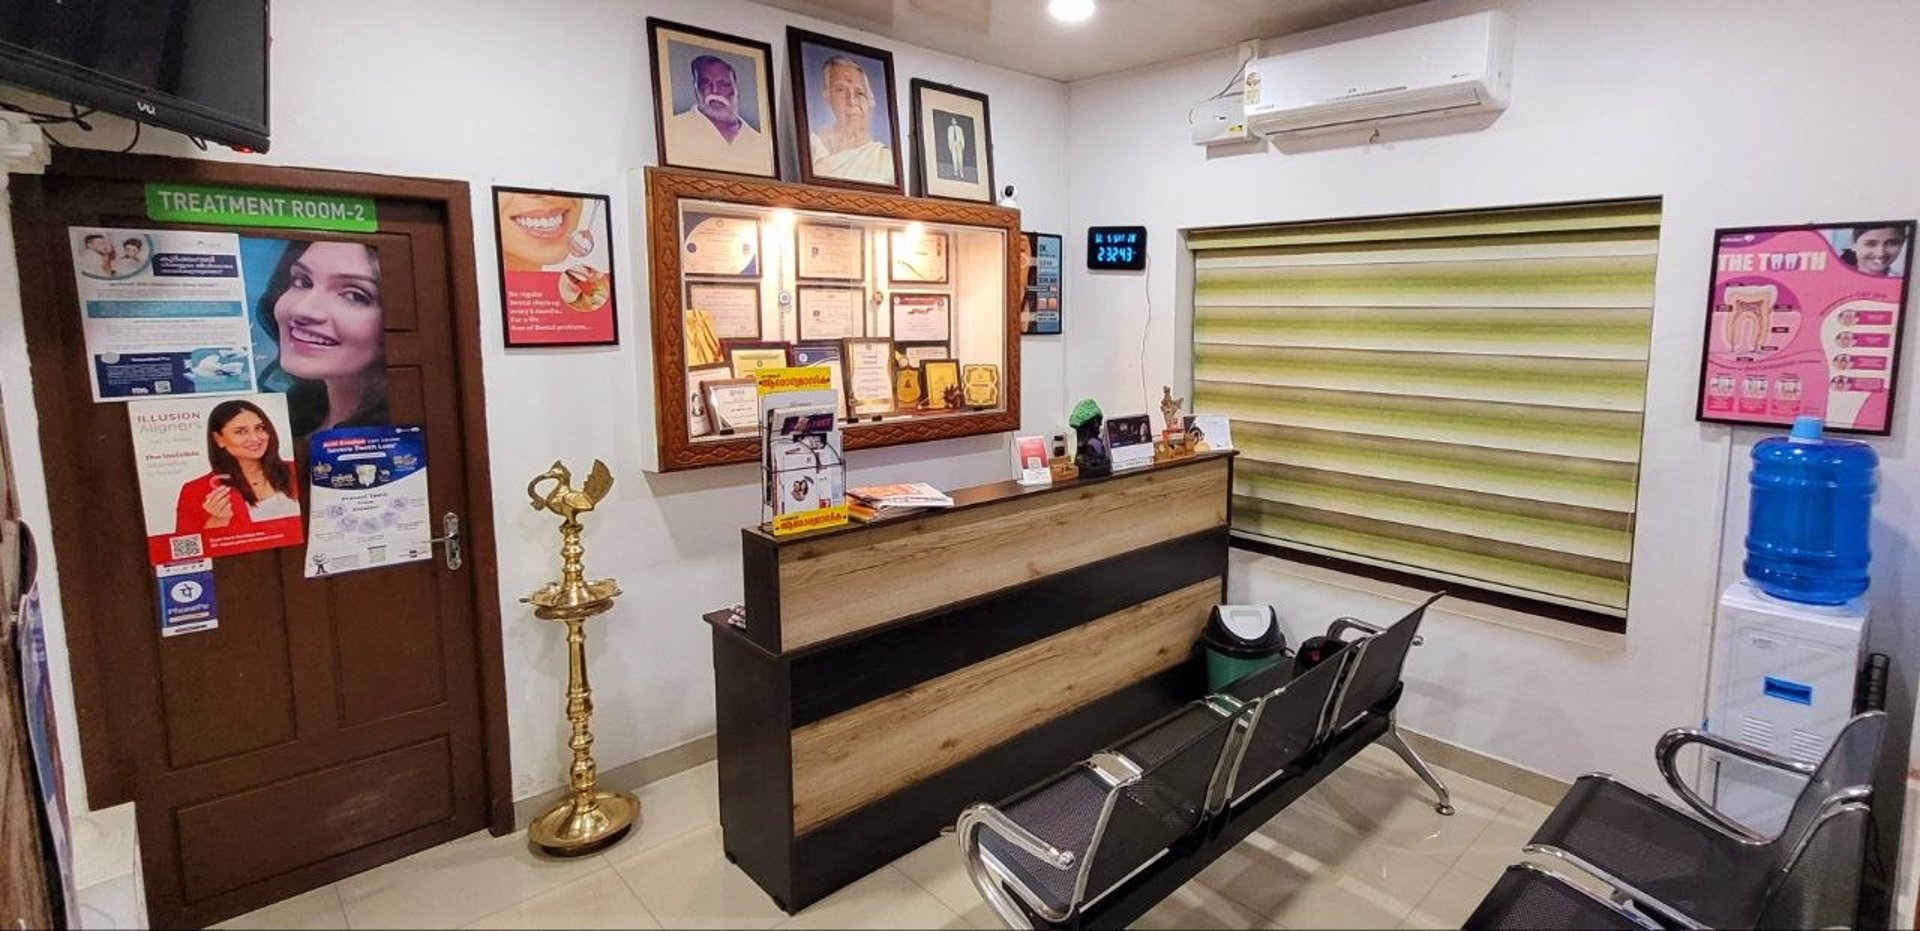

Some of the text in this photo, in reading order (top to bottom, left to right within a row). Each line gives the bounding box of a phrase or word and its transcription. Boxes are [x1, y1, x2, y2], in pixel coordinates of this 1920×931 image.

[157, 190, 365, 222] TREATMENT ROOM-2
[1717, 251, 1827, 273] THE TOOTH
[137, 411, 201, 423] ILLUSION
